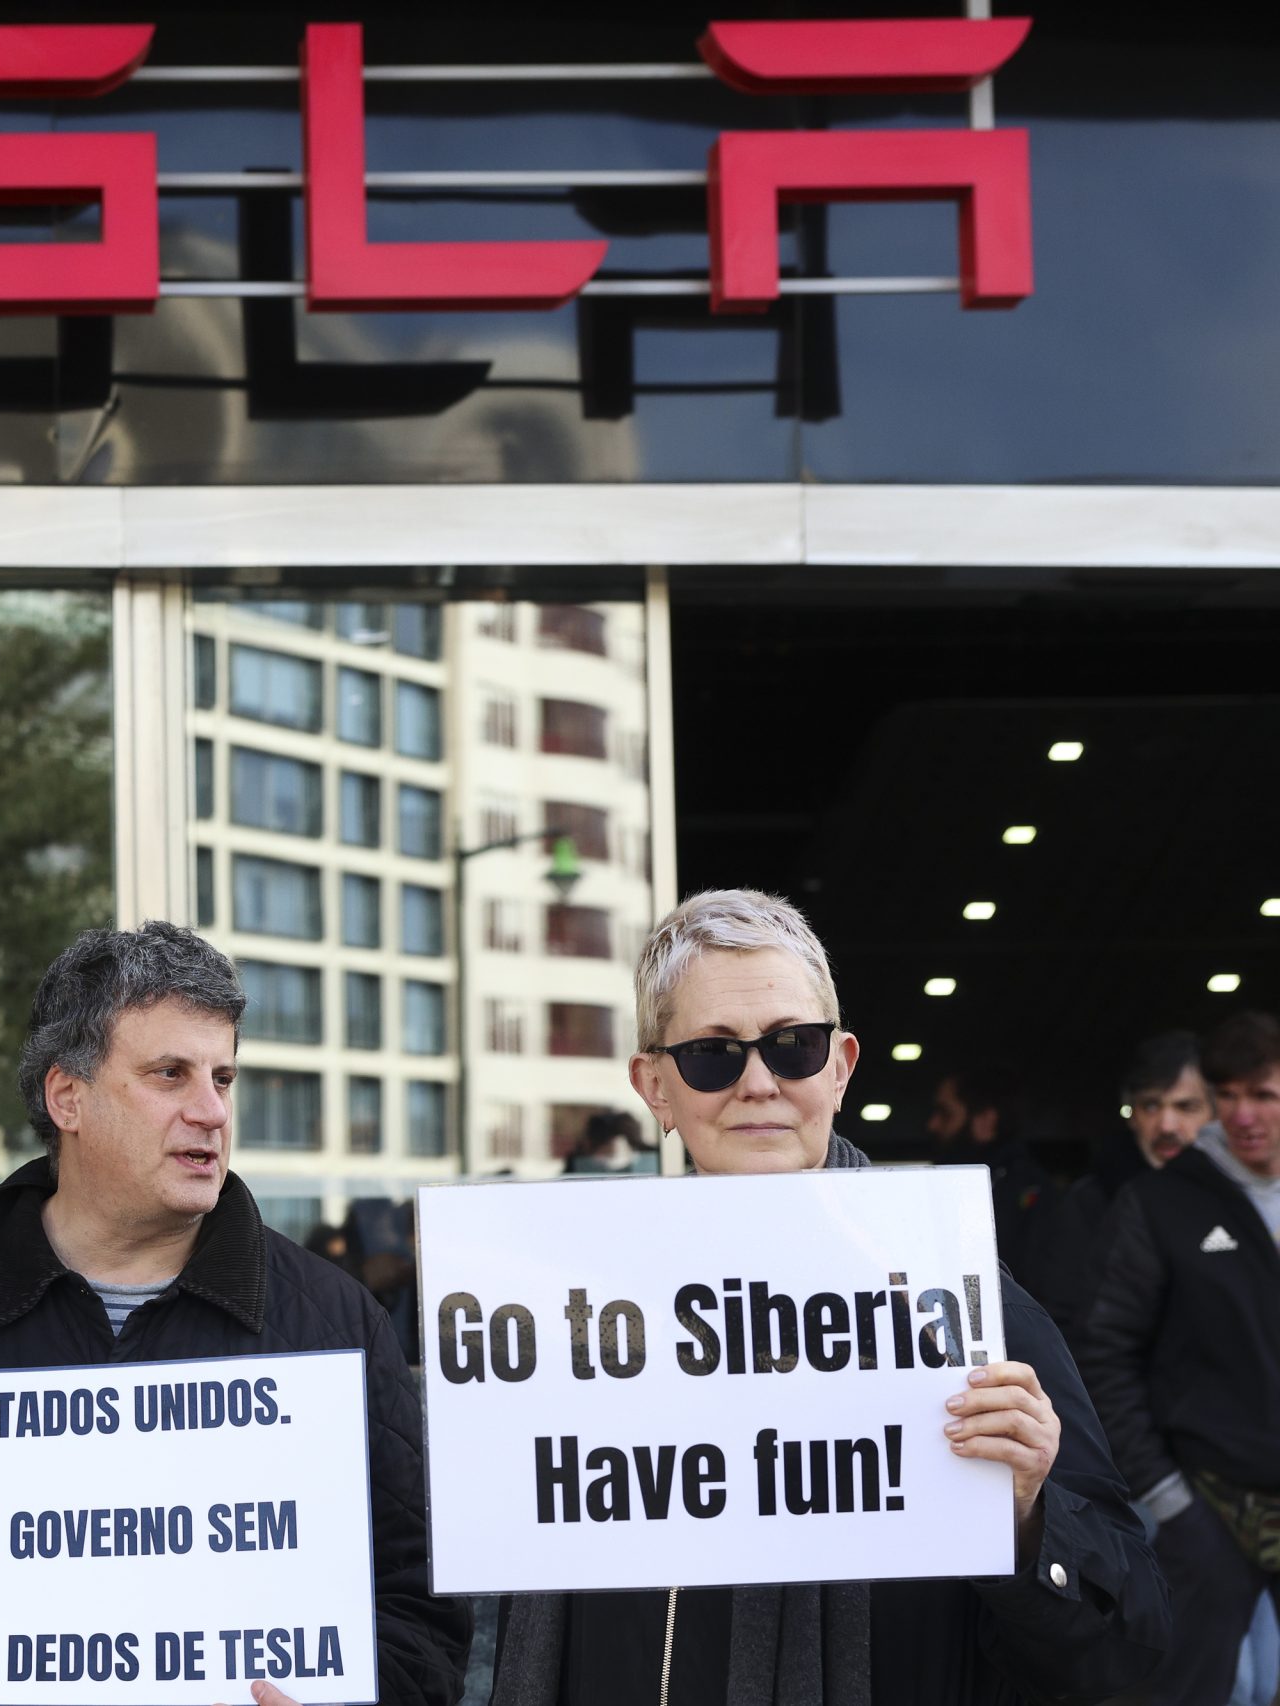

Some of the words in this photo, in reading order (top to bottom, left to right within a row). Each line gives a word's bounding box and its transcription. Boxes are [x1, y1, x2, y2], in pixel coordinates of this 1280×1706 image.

[437, 1291, 538, 1385] Go
[563, 1287, 647, 1381] to
[673, 1271, 989, 1377] Siberia!
[133, 1377, 292, 1433] UNIDOS.
[533, 1434, 727, 1525] Have
[753, 1424, 905, 1517] fun!
[9, 1505, 194, 1560] GOVERNO
[207, 1500, 298, 1554] SEM
[7, 1632, 140, 1682] DEDOS
[155, 1631, 205, 1682] DE
[219, 1625, 345, 1681] TESLA
